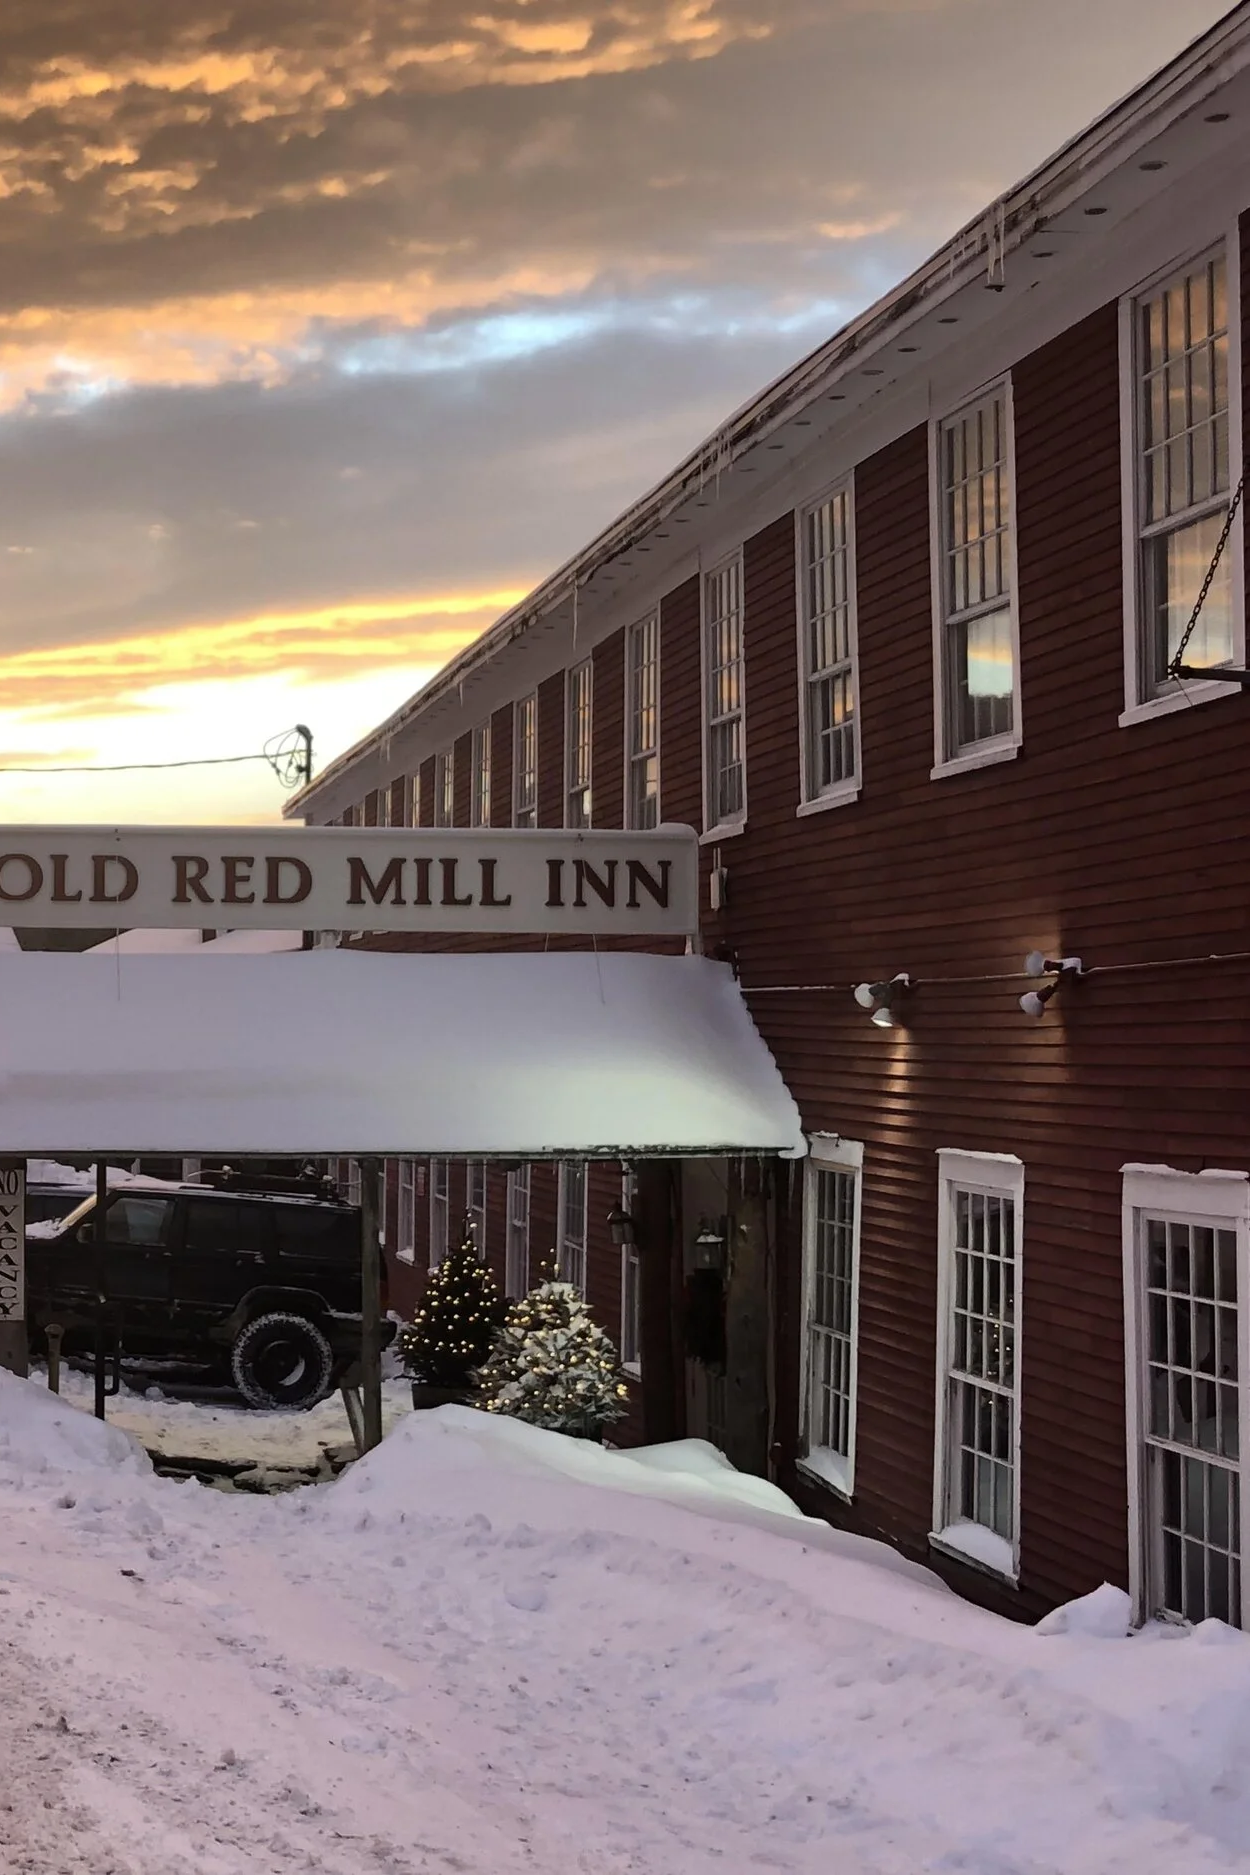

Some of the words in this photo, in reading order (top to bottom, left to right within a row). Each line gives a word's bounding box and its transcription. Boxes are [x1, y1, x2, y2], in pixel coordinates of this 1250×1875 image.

[171, 855, 313, 903] RED
[346, 857, 512, 906] MILL
[544, 859, 672, 909] INN
